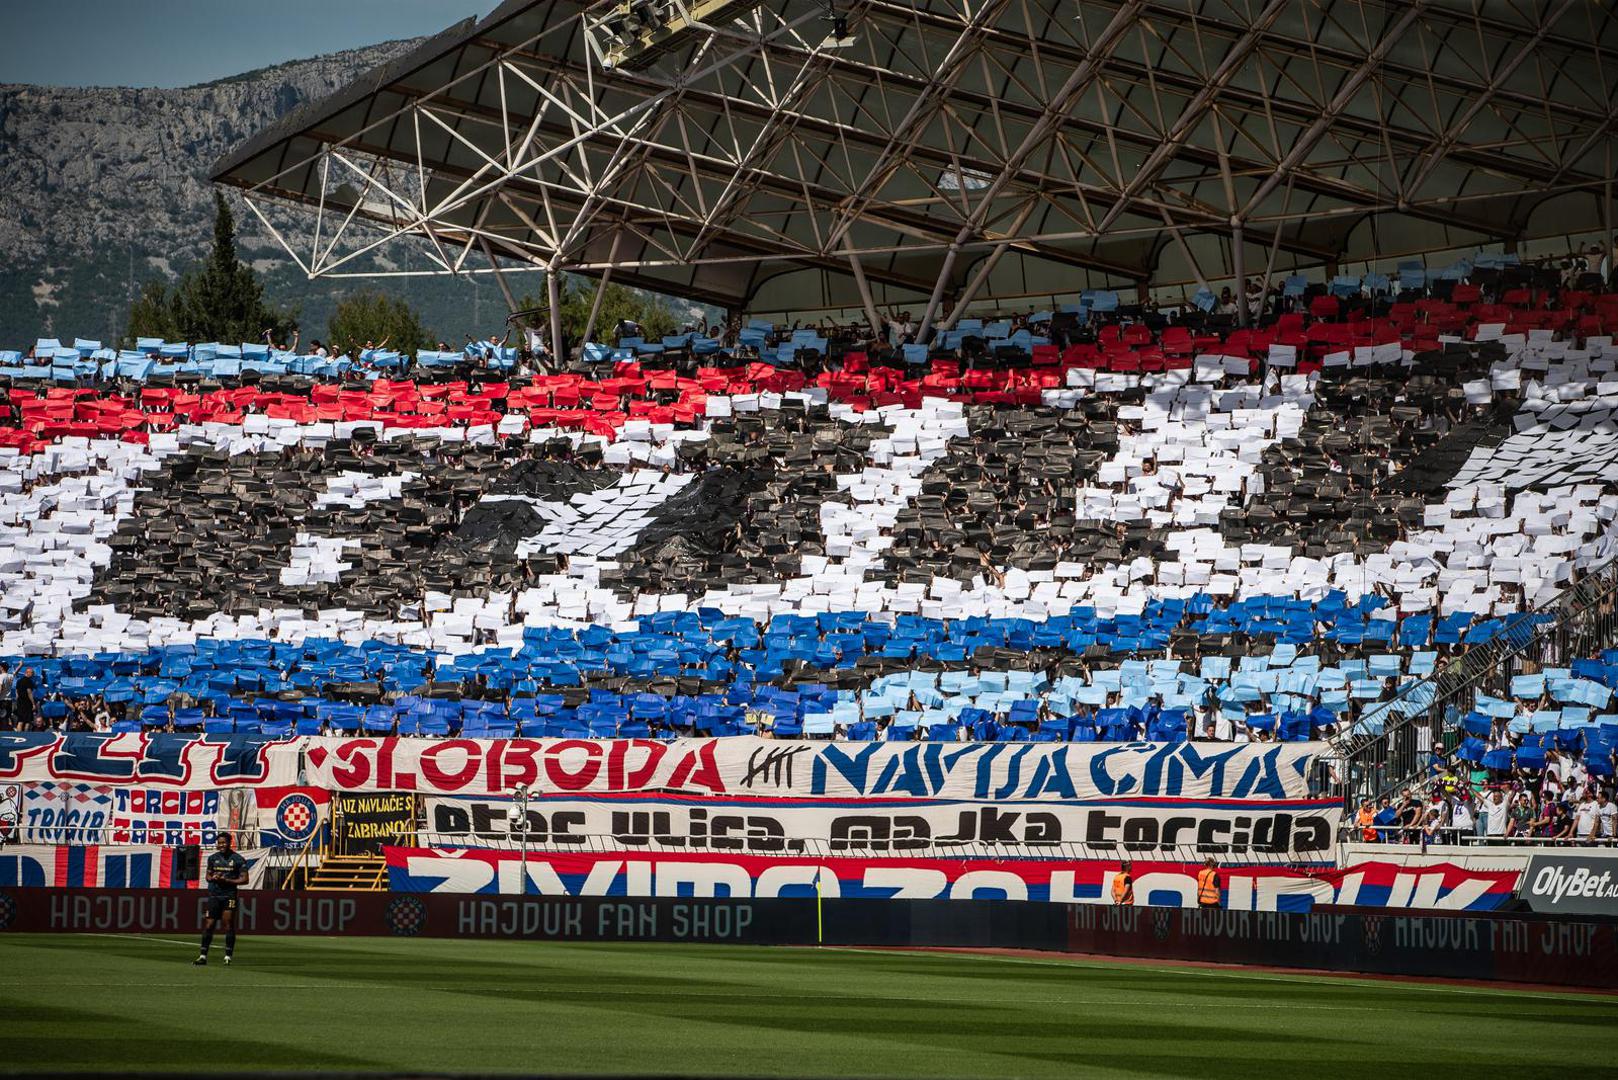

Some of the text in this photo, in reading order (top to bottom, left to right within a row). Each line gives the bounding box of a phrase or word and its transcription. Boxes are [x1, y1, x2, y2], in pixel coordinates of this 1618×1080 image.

[333, 737, 1286, 799] SLOBODA NAVIJAČIMA
[115, 788, 219, 815] TORCIDA
[342, 799, 357, 813] UZ
[28, 808, 105, 842] TROGIR
[113, 818, 217, 845] ZAGREB
[612, 808, 804, 853] ulica,
[830, 807, 1062, 850] majka
[1087, 810, 1331, 854] torcida
[1532, 865, 1612, 904] OlyBet
[51, 896, 179, 930] HAJDUK
[273, 898, 357, 932] SHOP
[457, 901, 582, 936] HAJDUK
[598, 904, 656, 937] FAN
[672, 905, 753, 938] SHOP
